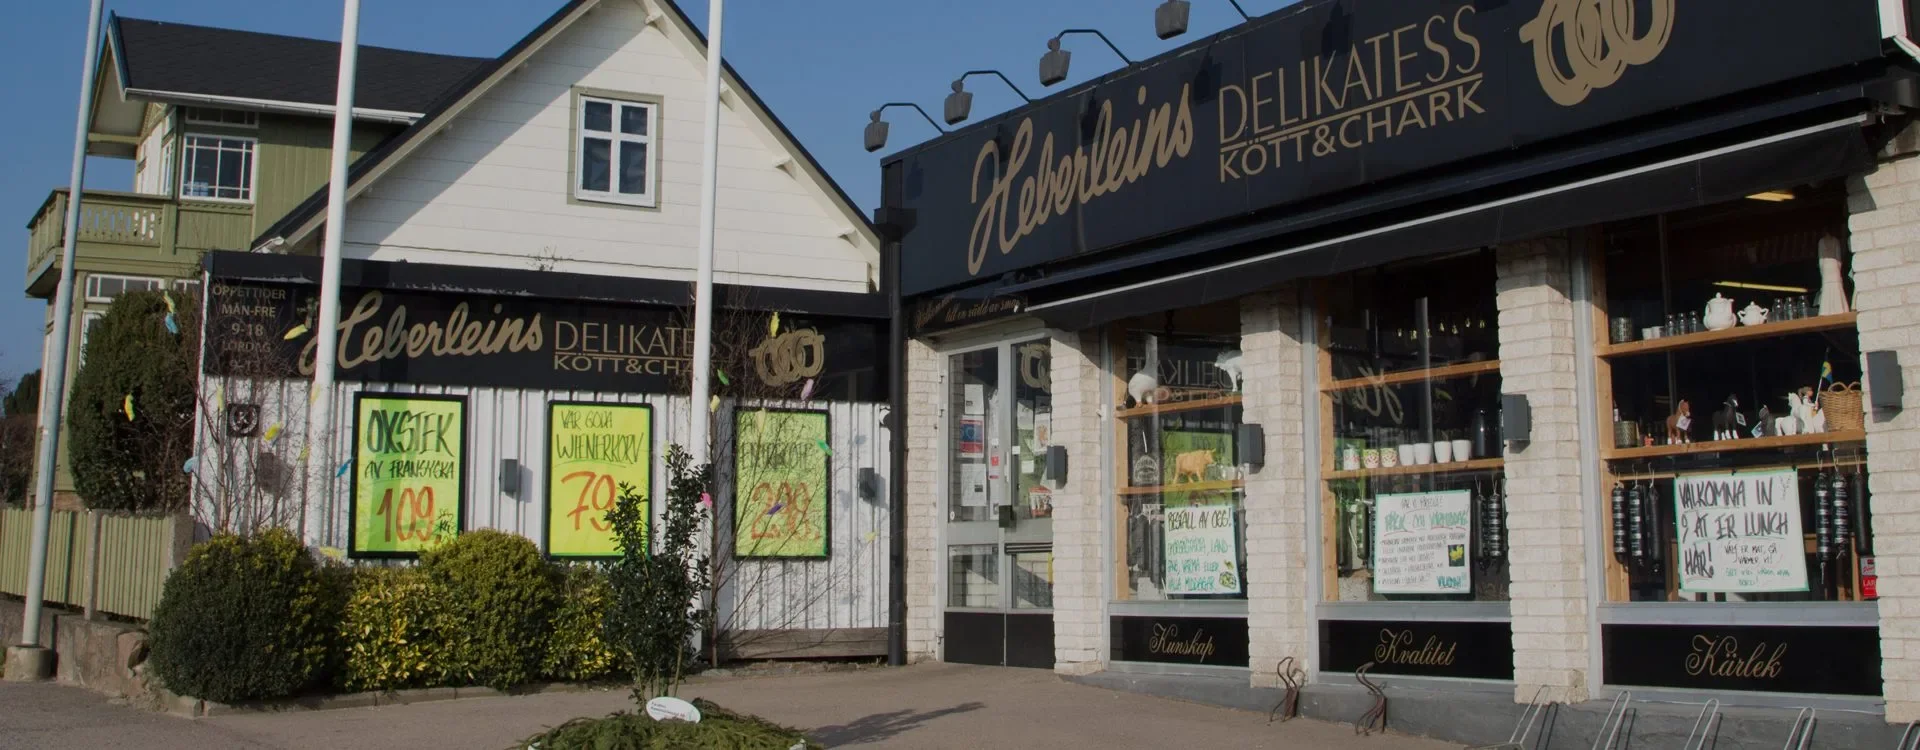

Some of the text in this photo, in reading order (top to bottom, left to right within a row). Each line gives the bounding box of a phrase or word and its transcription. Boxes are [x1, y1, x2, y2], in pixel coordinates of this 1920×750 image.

[1219, 5, 1481, 145] DELIKATESS
[1220, 80, 1486, 184] KÖTT&CHARK
[968, 82, 1194, 276] Heberleins
[212, 283, 287, 300] ÖPPETTIDER
[299, 289, 543, 376] Heberleins
[366, 409, 456, 457] OXSTEK
[364, 460, 384, 480] AV
[1757, 477, 1773, 506] IN
[561, 471, 616, 532] 79
[1716, 513, 1738, 540] ER
[1744, 512, 1789, 536] LUNCH
[1150, 622, 1215, 662] Kunskap
[1375, 628, 1457, 666] Kvalitet
[1685, 634, 1788, 678] Kärlek
